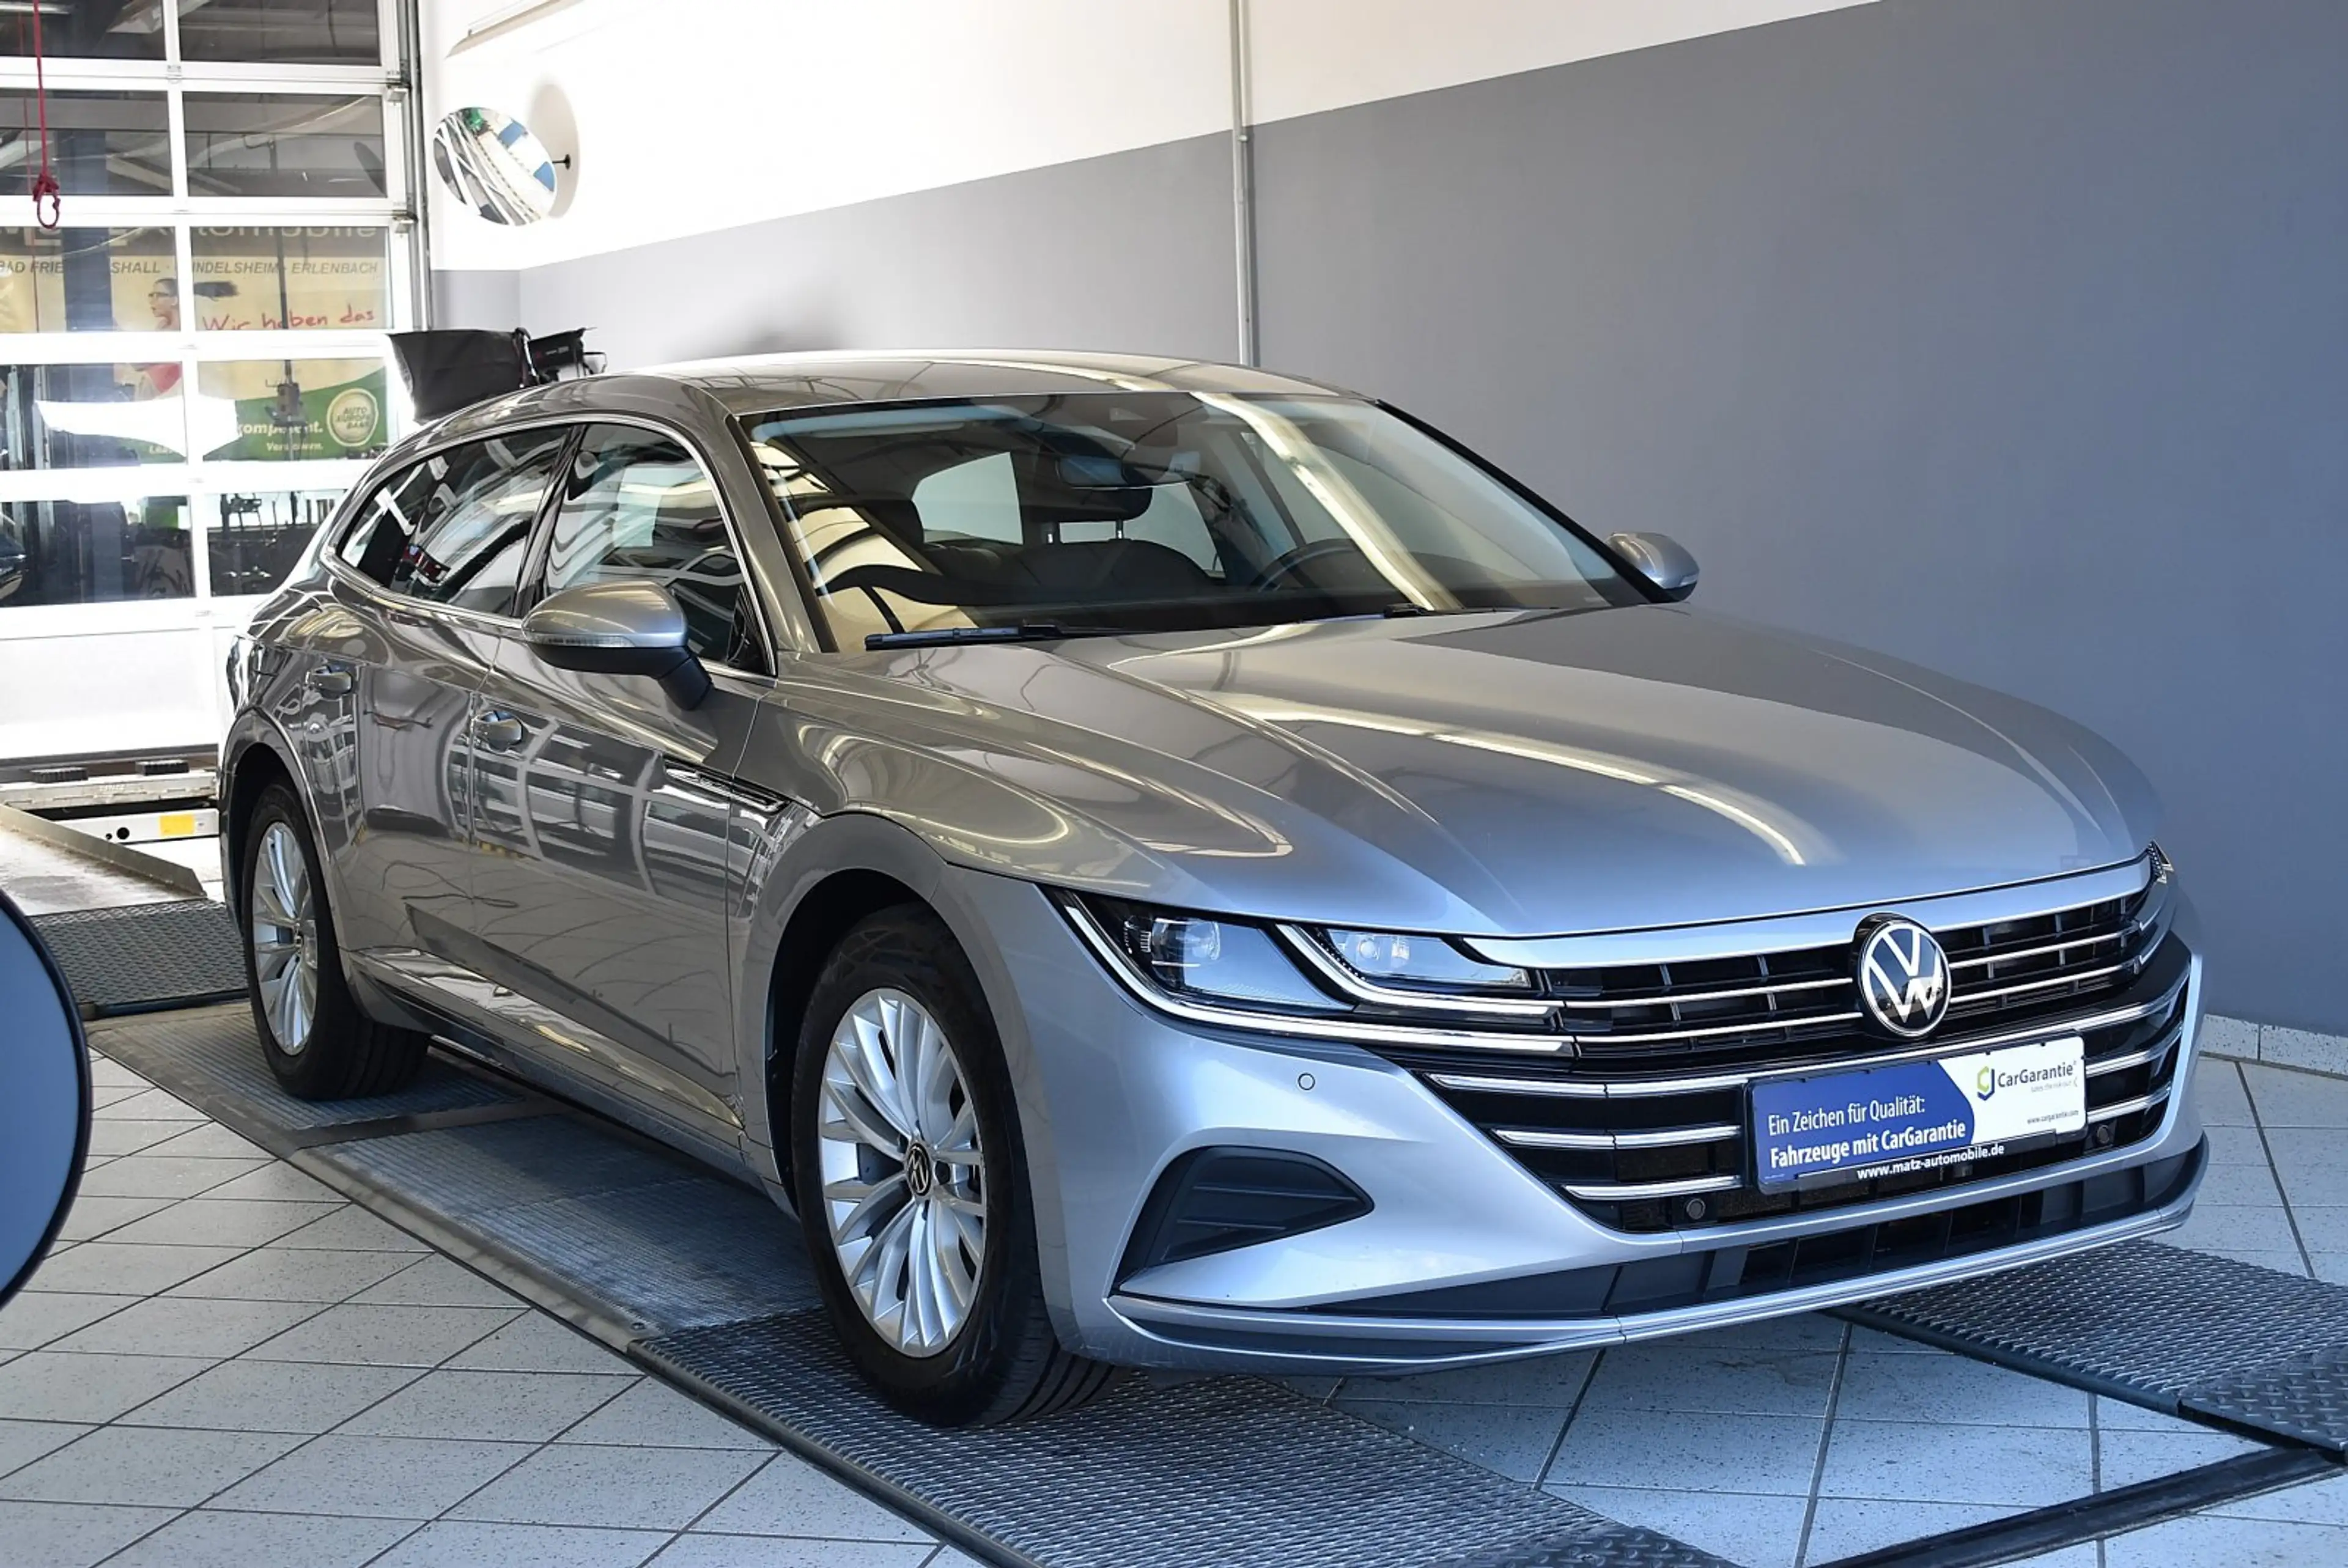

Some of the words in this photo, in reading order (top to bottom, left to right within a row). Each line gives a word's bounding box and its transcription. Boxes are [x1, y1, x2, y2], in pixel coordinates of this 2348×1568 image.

[291, 262, 378, 274] ERLENBACH
[202, 314, 251, 330] Wir
[341, 304, 375, 323] das
[1998, 1061, 2073, 1088] CarGarantie
[1768, 1113, 1790, 1136] Ein
[1792, 1108, 1844, 1132] Zeichen
[1848, 1103, 1867, 1124] für
[1870, 1094, 1925, 1122] Qualität:
[1770, 1140, 1850, 1169] Fahrzeuge
[1853, 1132, 1879, 1155] mit
[1881, 1119, 1966, 1150] CarGarantie
[1856, 1144, 2005, 1180] www.matz-automobile.de
